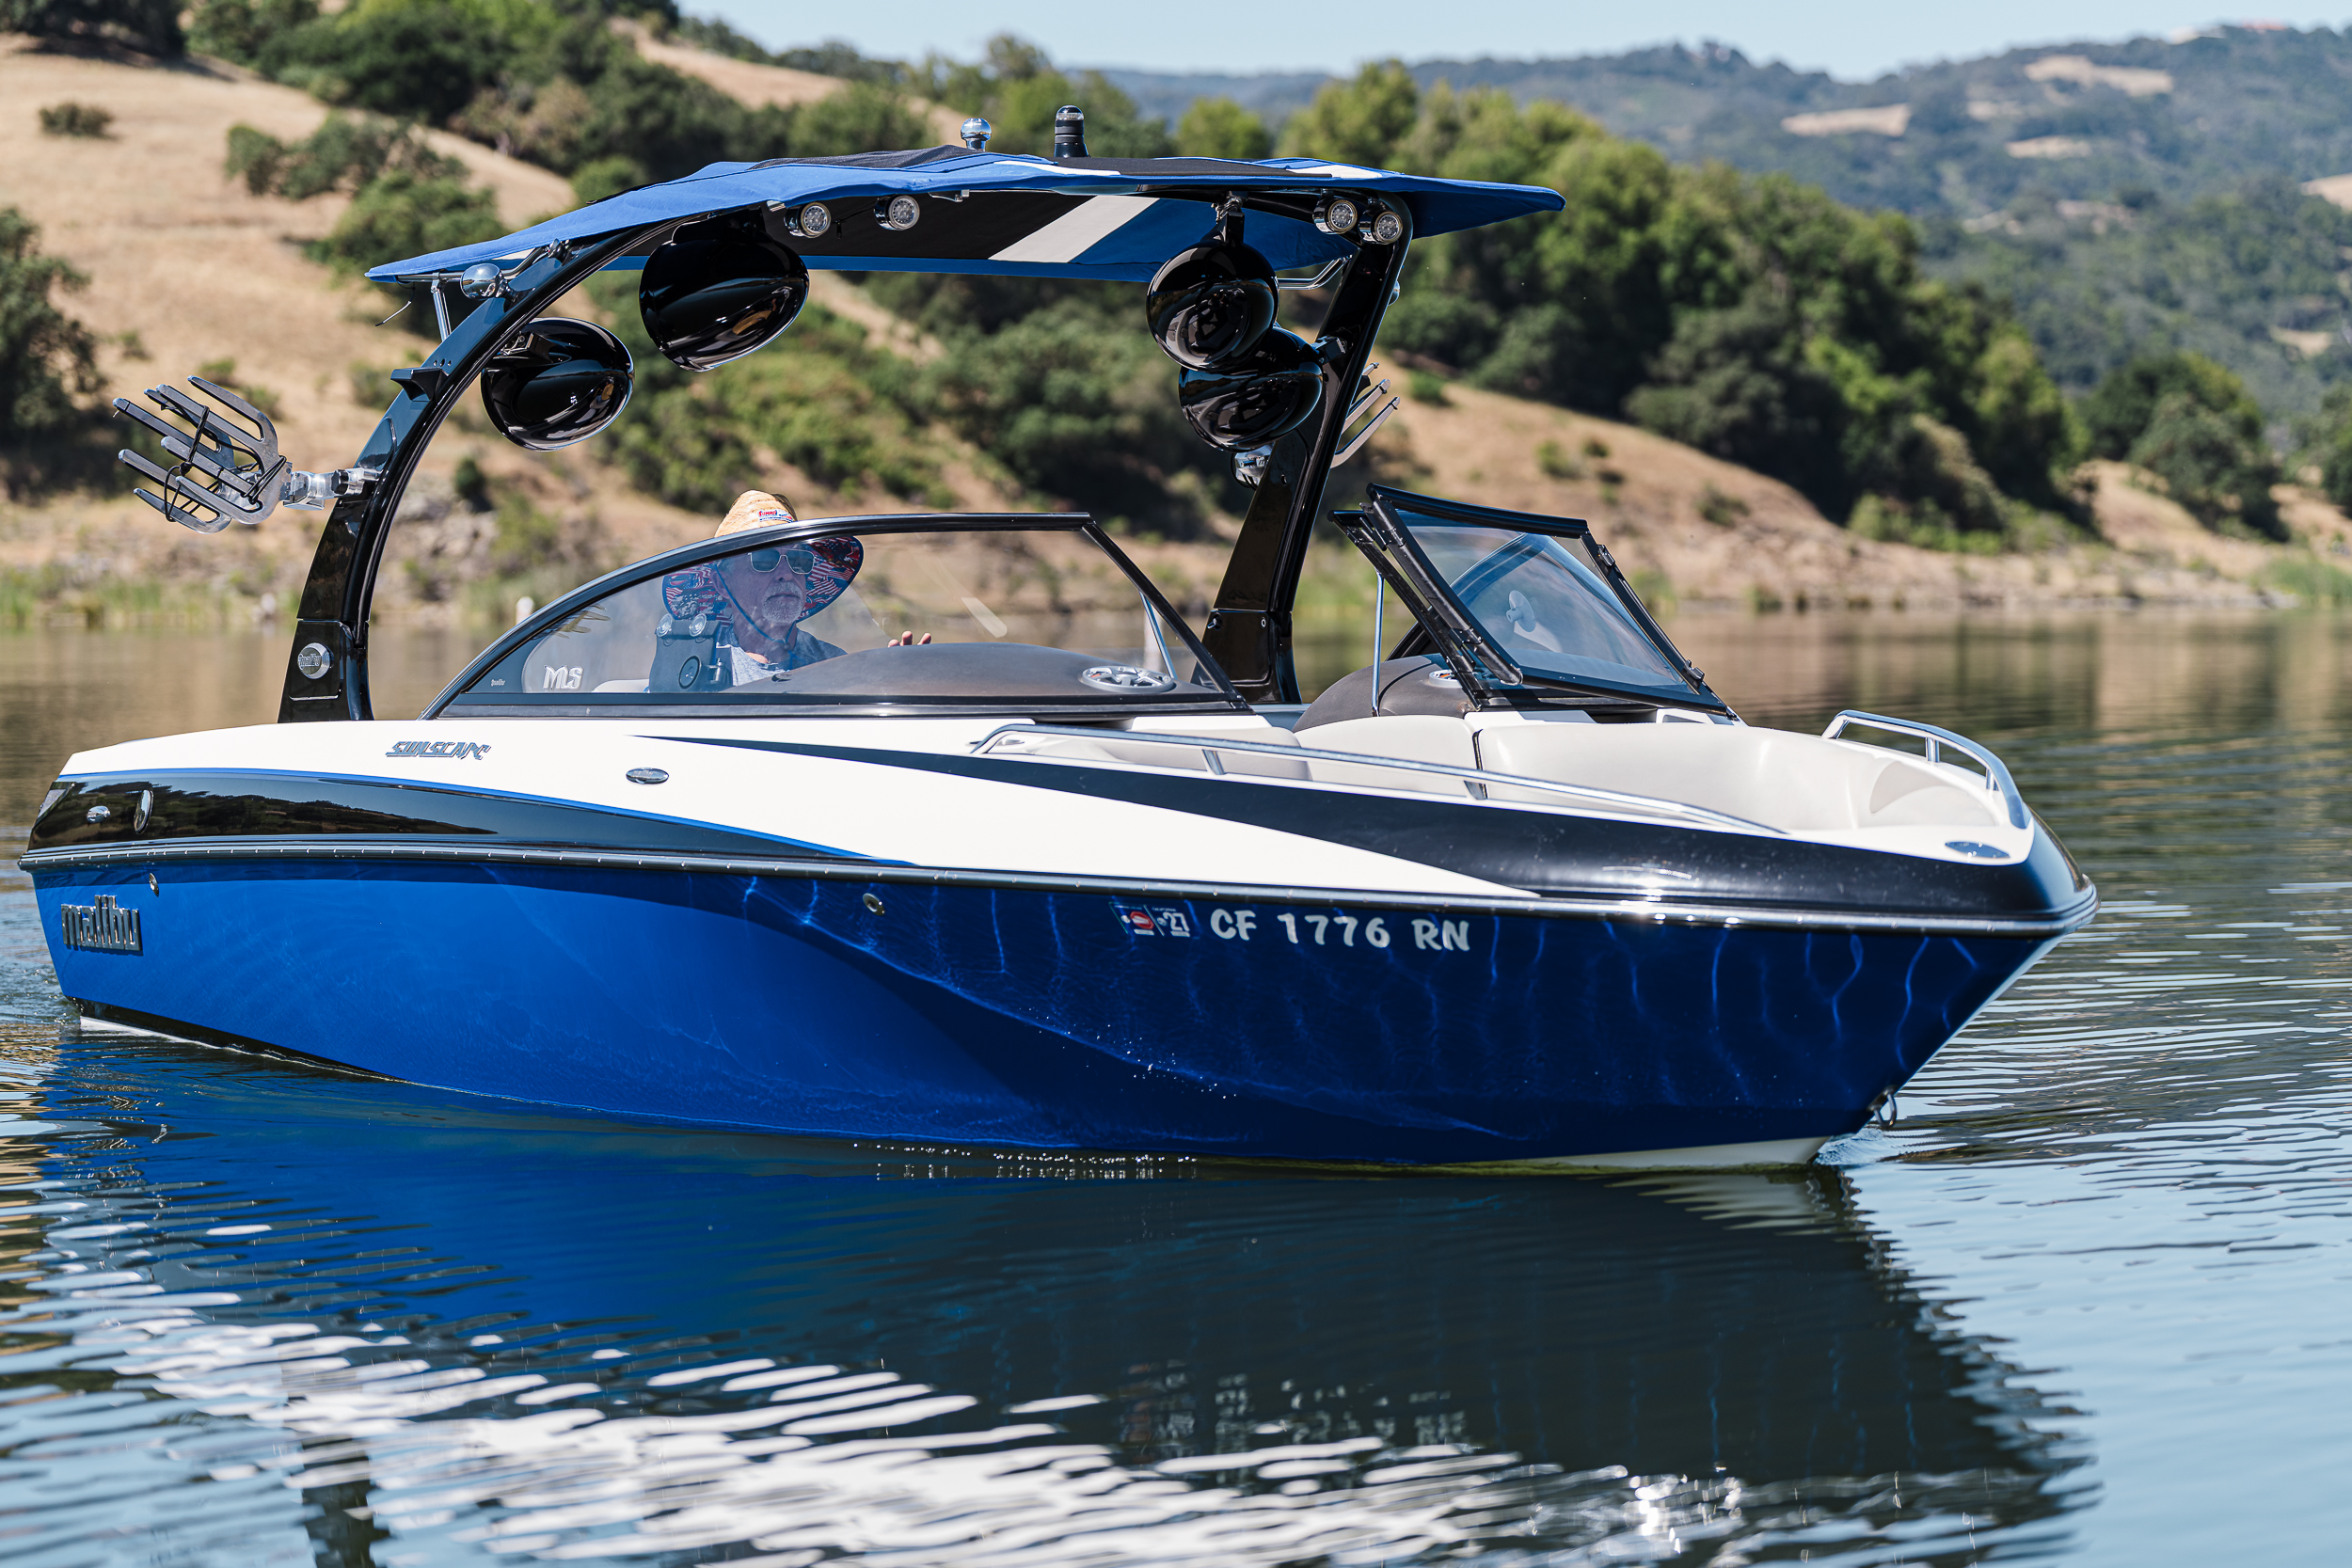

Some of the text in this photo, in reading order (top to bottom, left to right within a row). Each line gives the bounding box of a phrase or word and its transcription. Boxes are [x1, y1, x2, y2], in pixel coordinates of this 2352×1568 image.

[61, 895, 141, 951] malibu
[1210, 909, 1470, 952] CF 1776 RN
